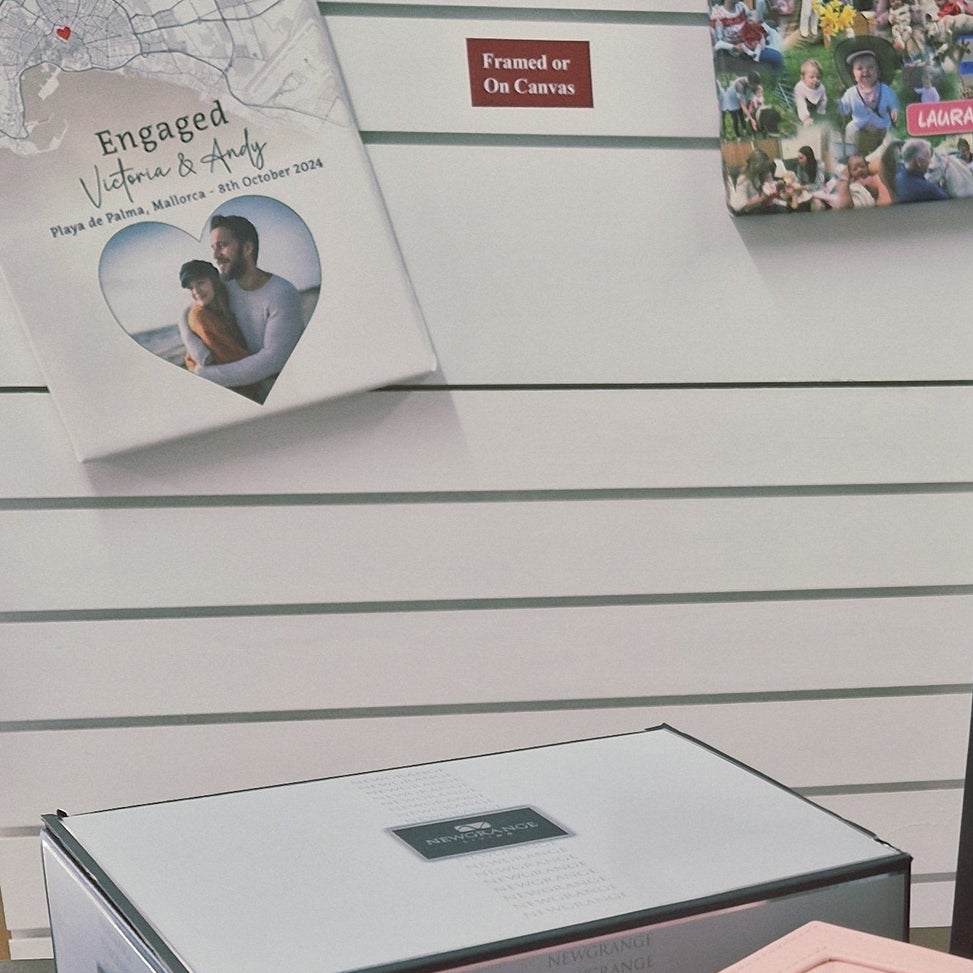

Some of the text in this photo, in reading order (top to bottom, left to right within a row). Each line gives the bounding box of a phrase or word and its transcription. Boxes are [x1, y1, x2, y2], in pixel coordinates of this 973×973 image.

[482, 52, 571, 71] Framed or
[483, 77, 576, 97] On Canvas
[95, 100, 229, 156] Engaged
[80, 128, 267, 209] Victoria & Andy
[50, 223, 86, 238] Playa
[88, 217, 104, 228] de
[106, 206, 150, 224] Palma,
[152, 190, 206, 211] Mallorca
[217, 180, 240, 195] 8th
[242, 167, 291, 188] October
[294, 157, 324, 175] 2024
[425, 821, 540, 846] NEWGRANGE
[549, 934, 652, 968] NEWGRANGE
